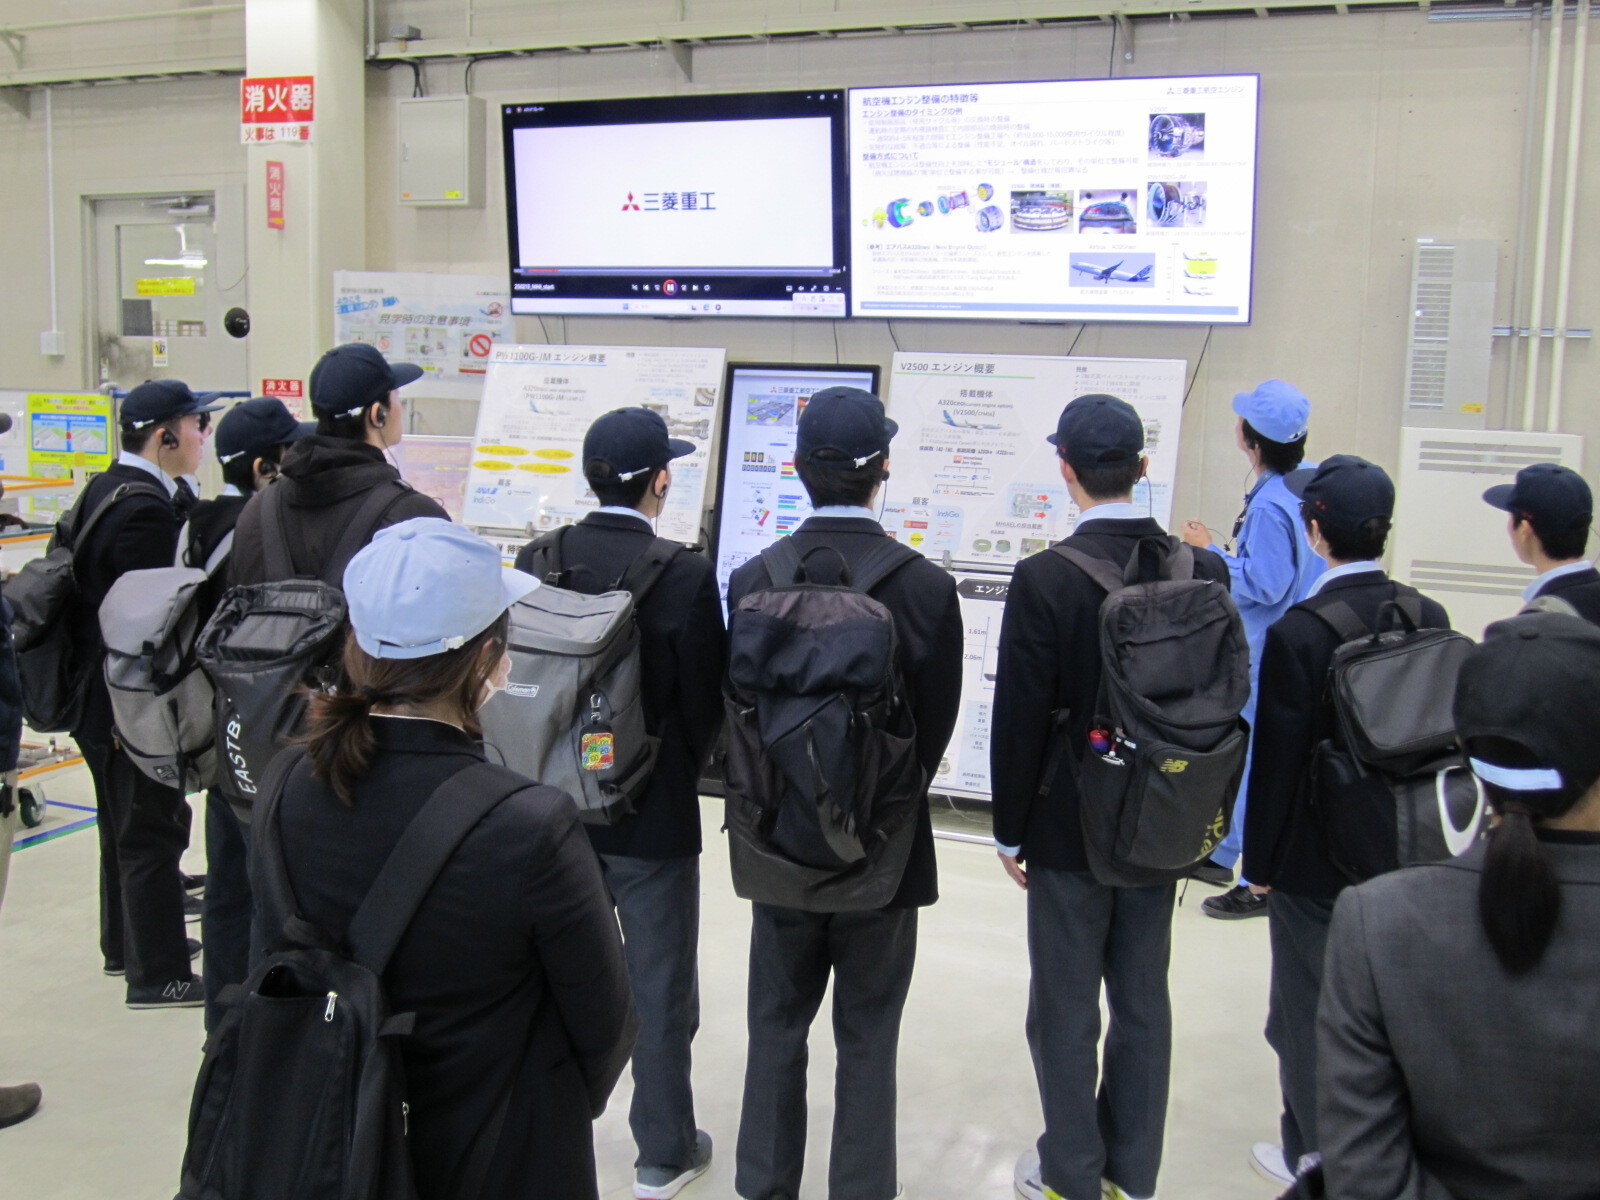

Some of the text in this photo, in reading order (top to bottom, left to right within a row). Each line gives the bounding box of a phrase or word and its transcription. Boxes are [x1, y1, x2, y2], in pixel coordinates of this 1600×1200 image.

[245, 84, 312, 112] 消火器
[862, 93, 979, 106] 航空機エンジン整備の特徴等
[862, 107, 963, 118] エンジン整備のタイミングの例
[245, 127, 275, 141] 火事は
[268, 166, 281, 212] 消火器
[643, 191, 717, 211] 三菱重工
[379, 313, 471, 327] 見学時の注意事項
[553, 353, 607, 364] エンジン概要
[900, 362, 996, 375] V2500 エンジン概要
[265, 380, 299, 392] 消火器
[959, 388, 994, 399] 搭載機体
[937, 510, 960, 518] IndiGo
[964, 653, 983, 661] 2.06m
[226, 713, 258, 795] EASTB
